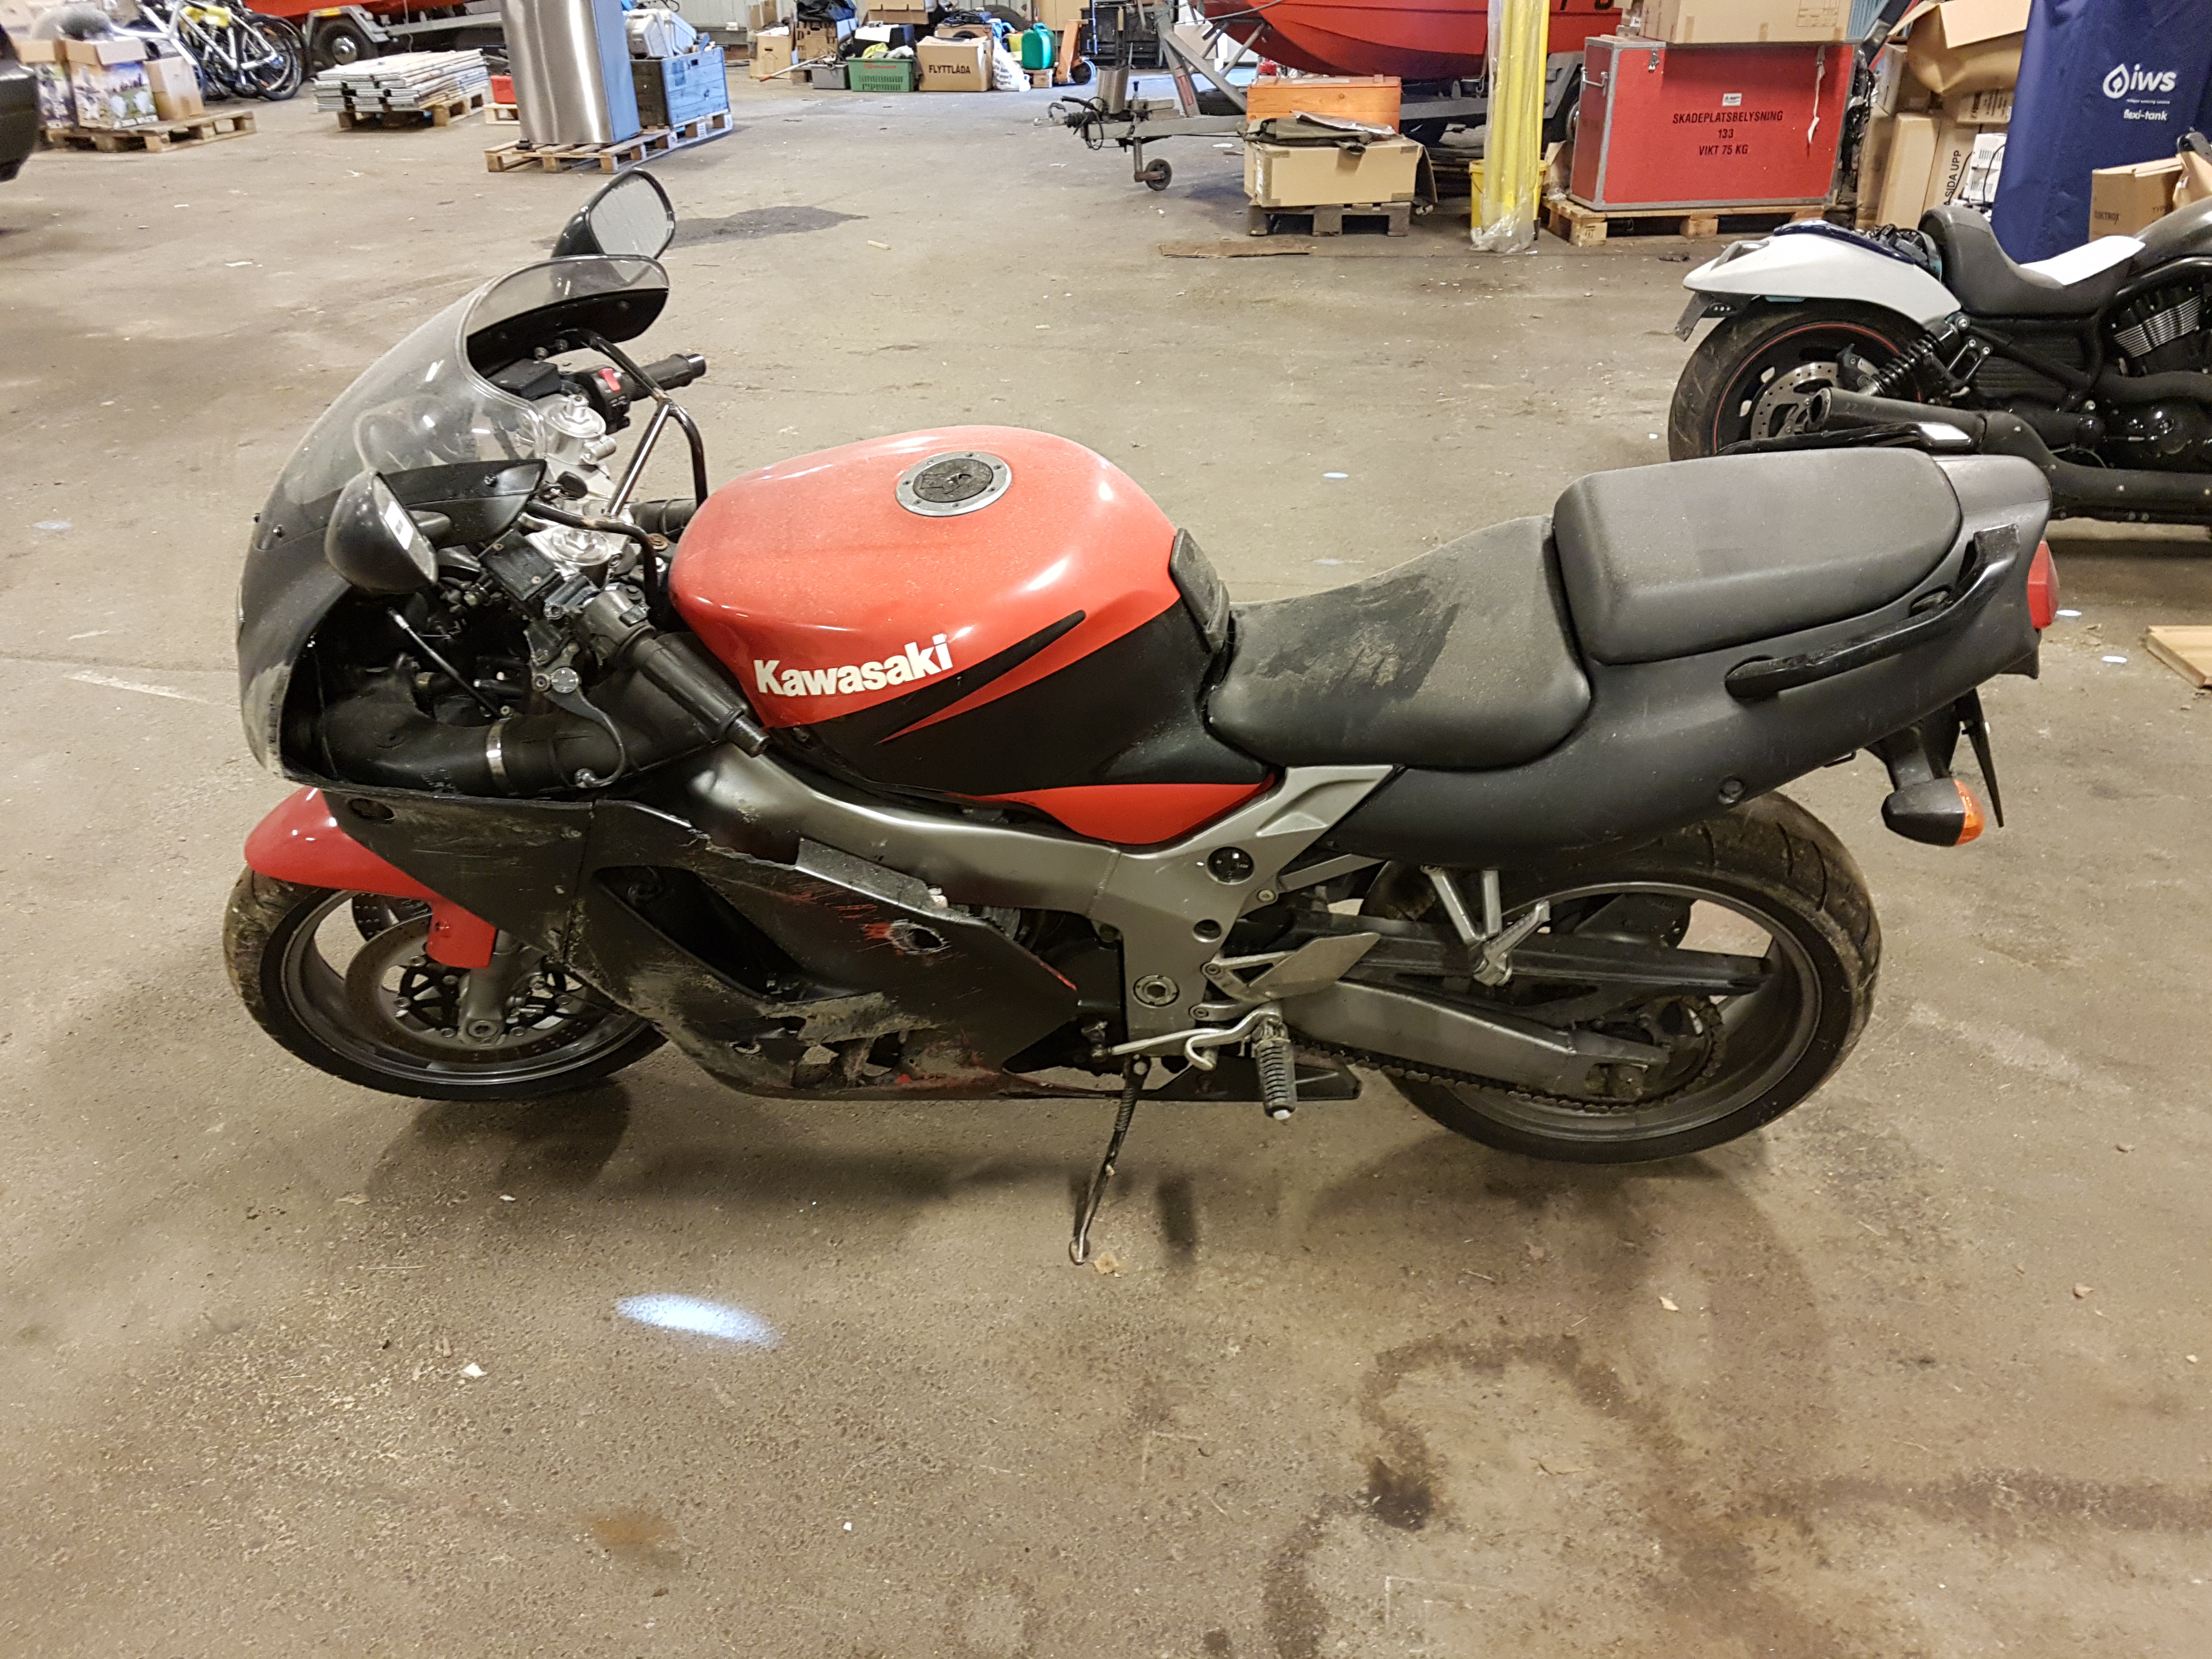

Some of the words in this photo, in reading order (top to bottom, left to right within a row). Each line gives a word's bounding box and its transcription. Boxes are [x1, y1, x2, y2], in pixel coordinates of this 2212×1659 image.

[929, 64, 970, 74] FLYTTLÅDA
[2130, 64, 2177, 92] iws
[1673, 110, 1783, 124] SKADEPLATSBELYSNING
[2124, 109, 2168, 121] flexi-tank
[1718, 128, 1734, 138] 133
[1699, 145, 1719, 156] VIKT
[1722, 145, 1733, 155] 75
[1735, 144, 1748, 155] KG
[1950, 150, 1962, 171] UPP
[1945, 173, 1957, 198] SIDA
[753, 633, 953, 697] Kawasaki
